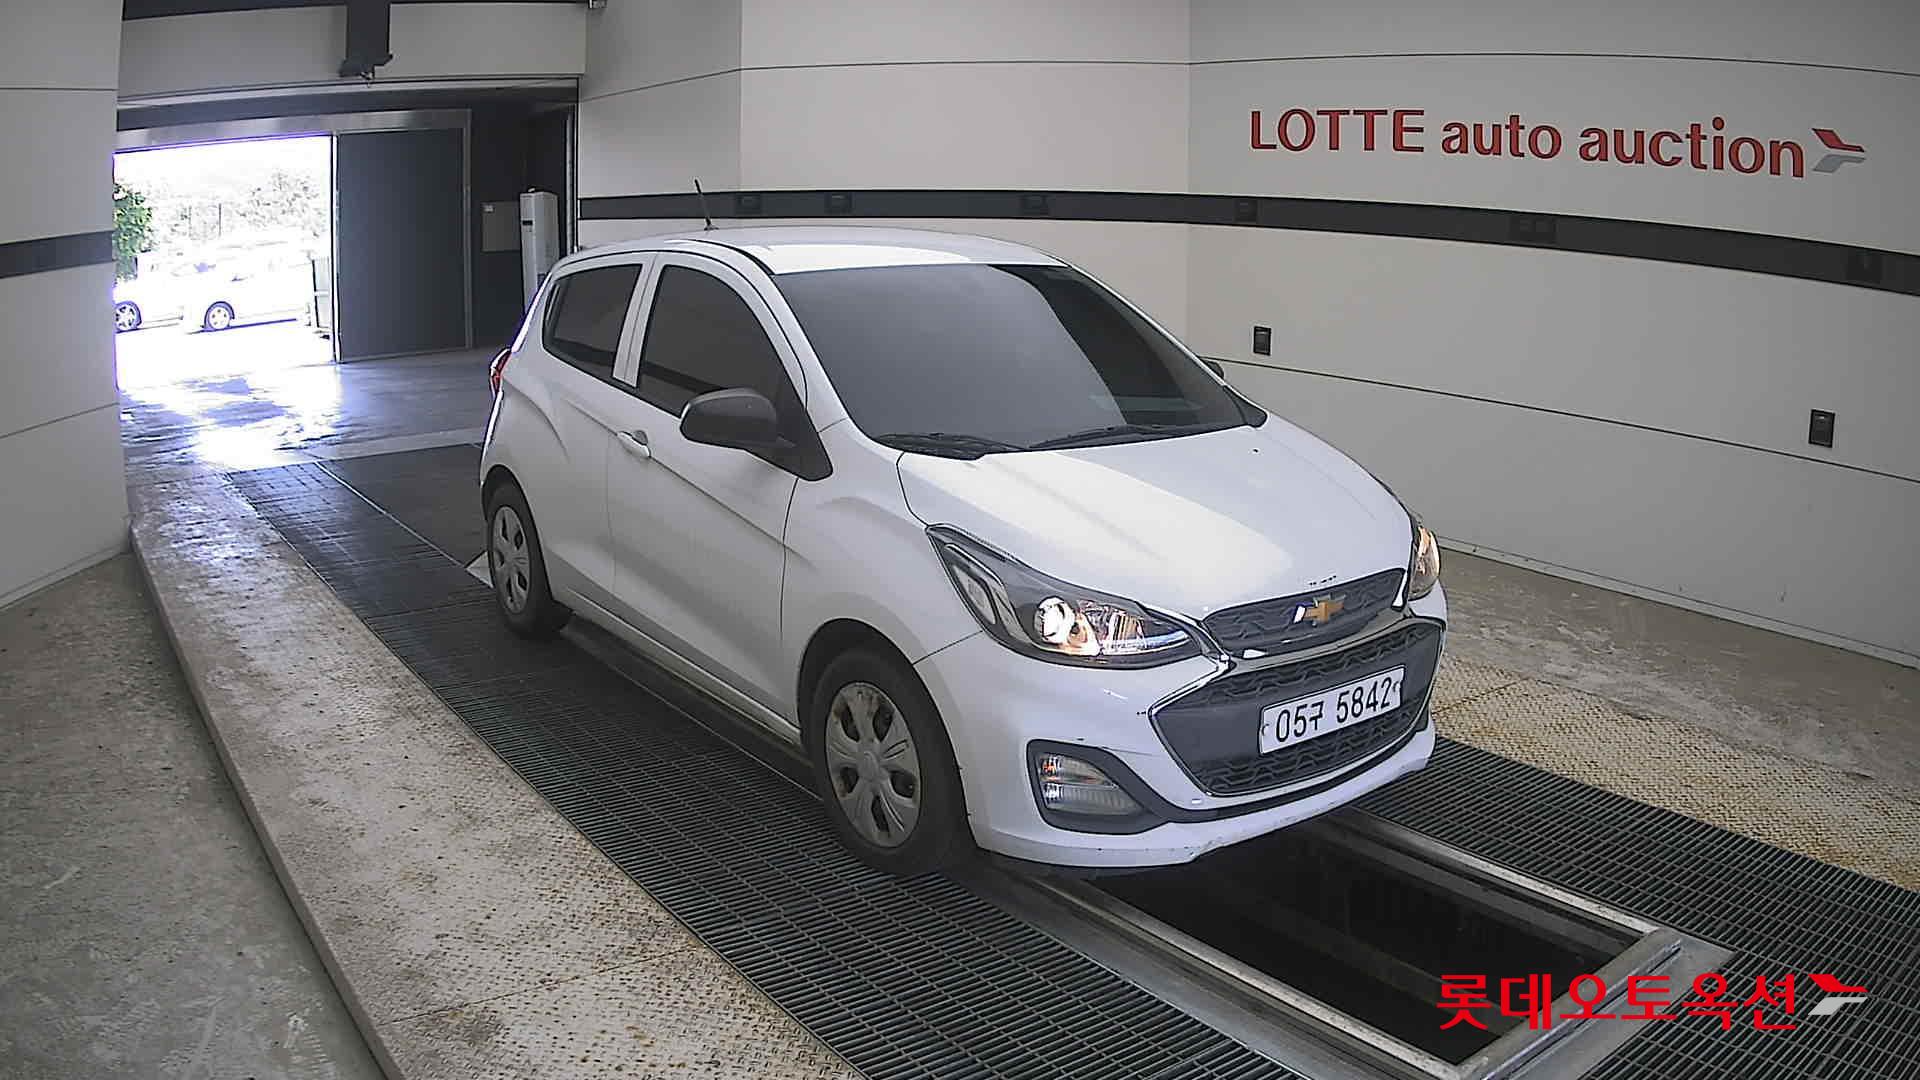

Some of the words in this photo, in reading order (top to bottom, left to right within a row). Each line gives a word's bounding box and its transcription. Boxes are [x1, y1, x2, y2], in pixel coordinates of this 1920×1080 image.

[1249, 109, 1425, 153] LOTTE
[1441, 114, 1562, 159] auto
[1578, 116, 1805, 178] auction
[1276, 701, 1325, 742] 05구
[1336, 677, 1392, 723] 5842
